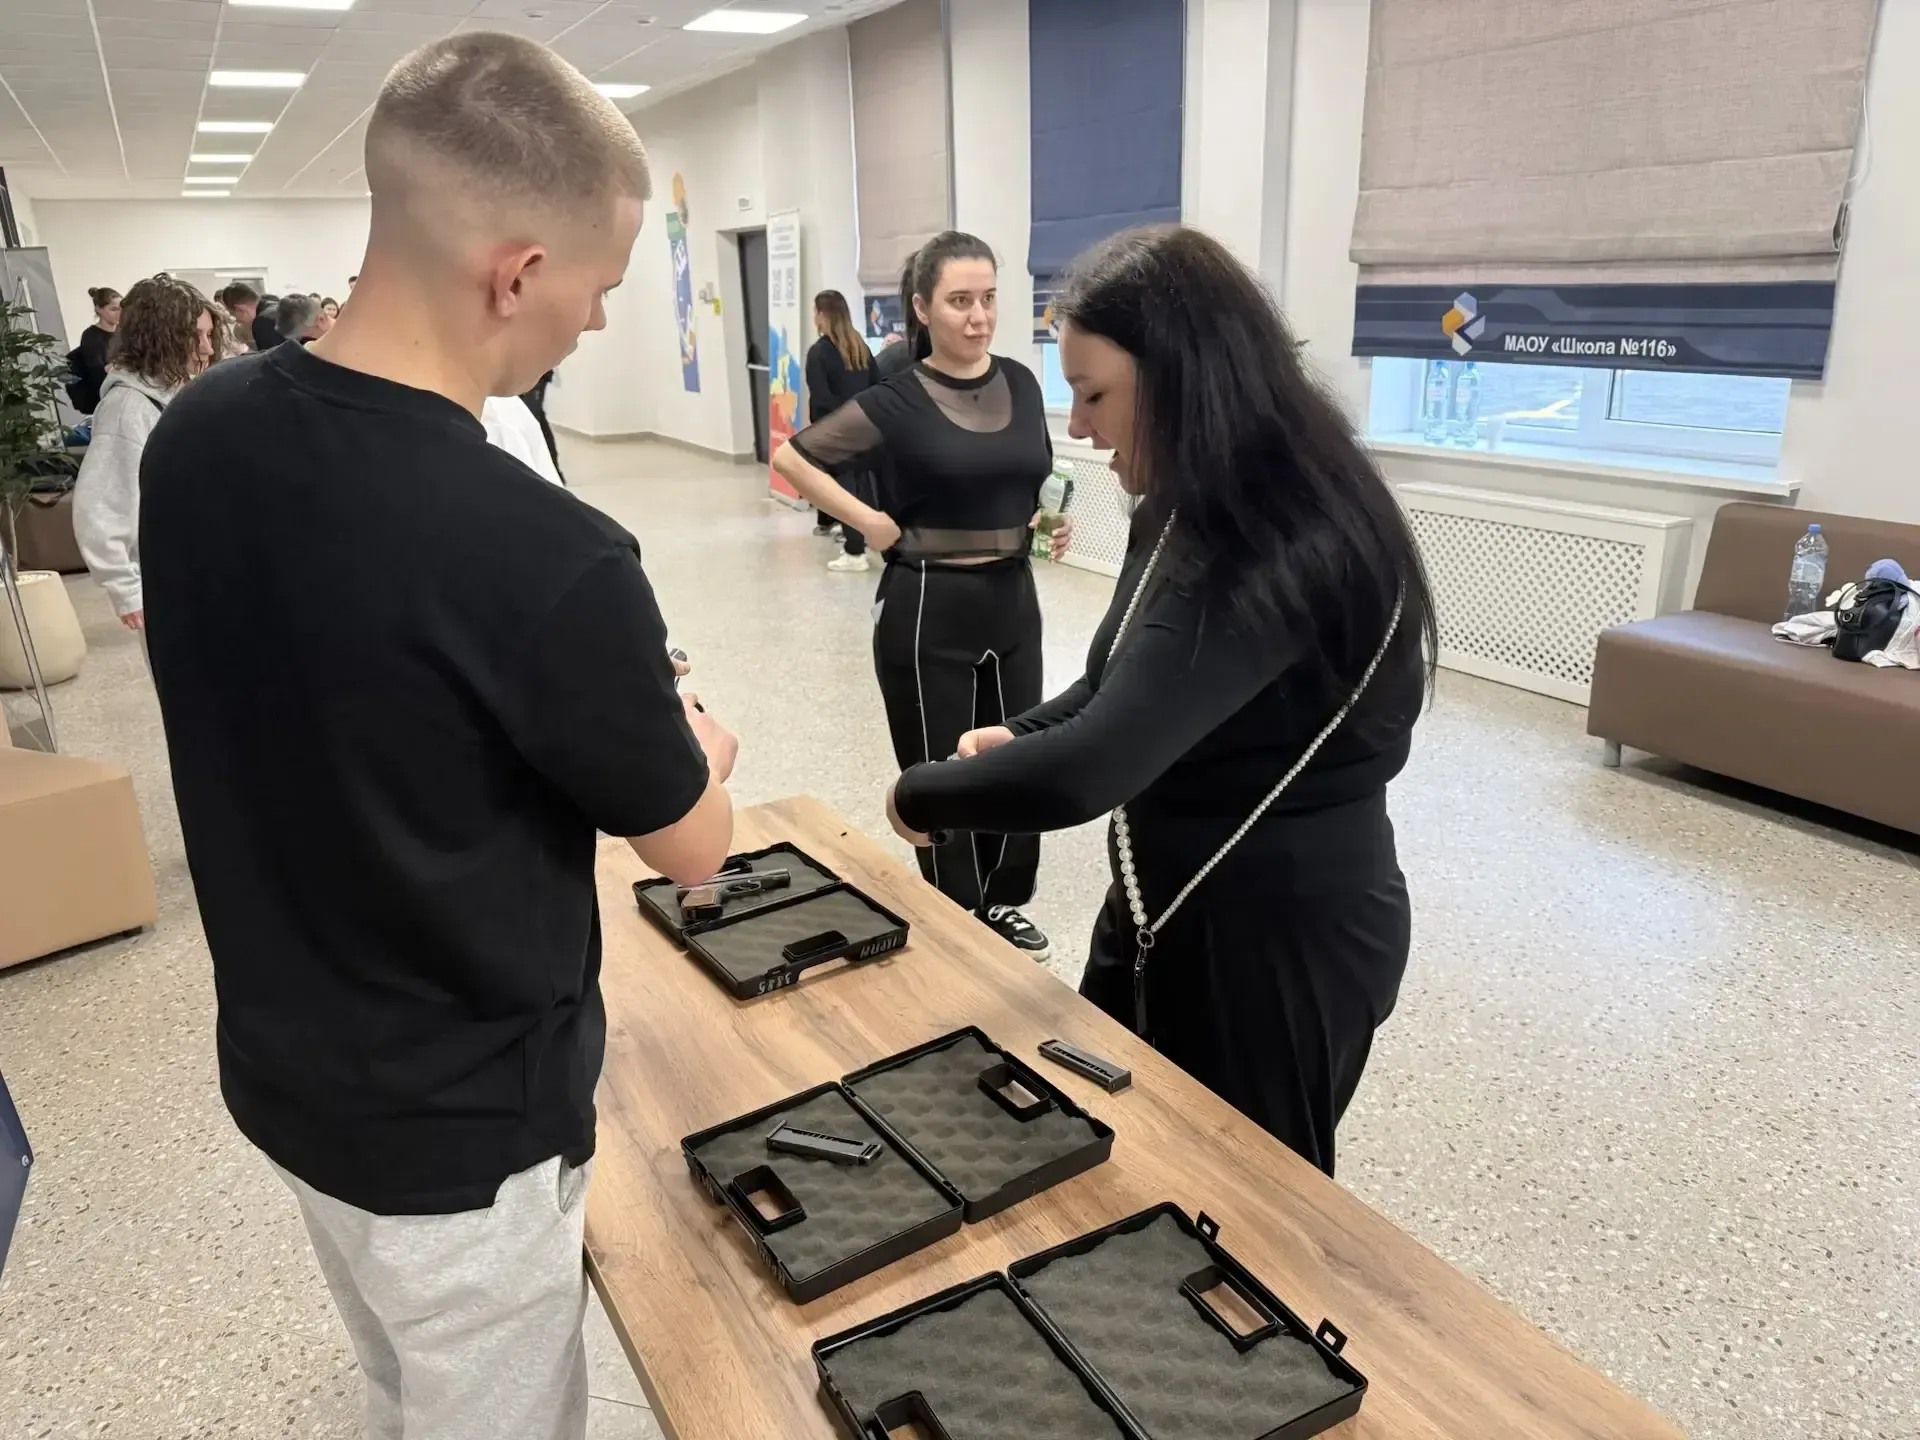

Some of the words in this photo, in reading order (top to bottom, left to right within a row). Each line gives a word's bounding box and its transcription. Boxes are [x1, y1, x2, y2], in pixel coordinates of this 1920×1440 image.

[1504, 334, 1550, 353] МАОУ
[1551, 337, 1615, 355] «Школа
[1620, 338, 1677, 357] №116»
